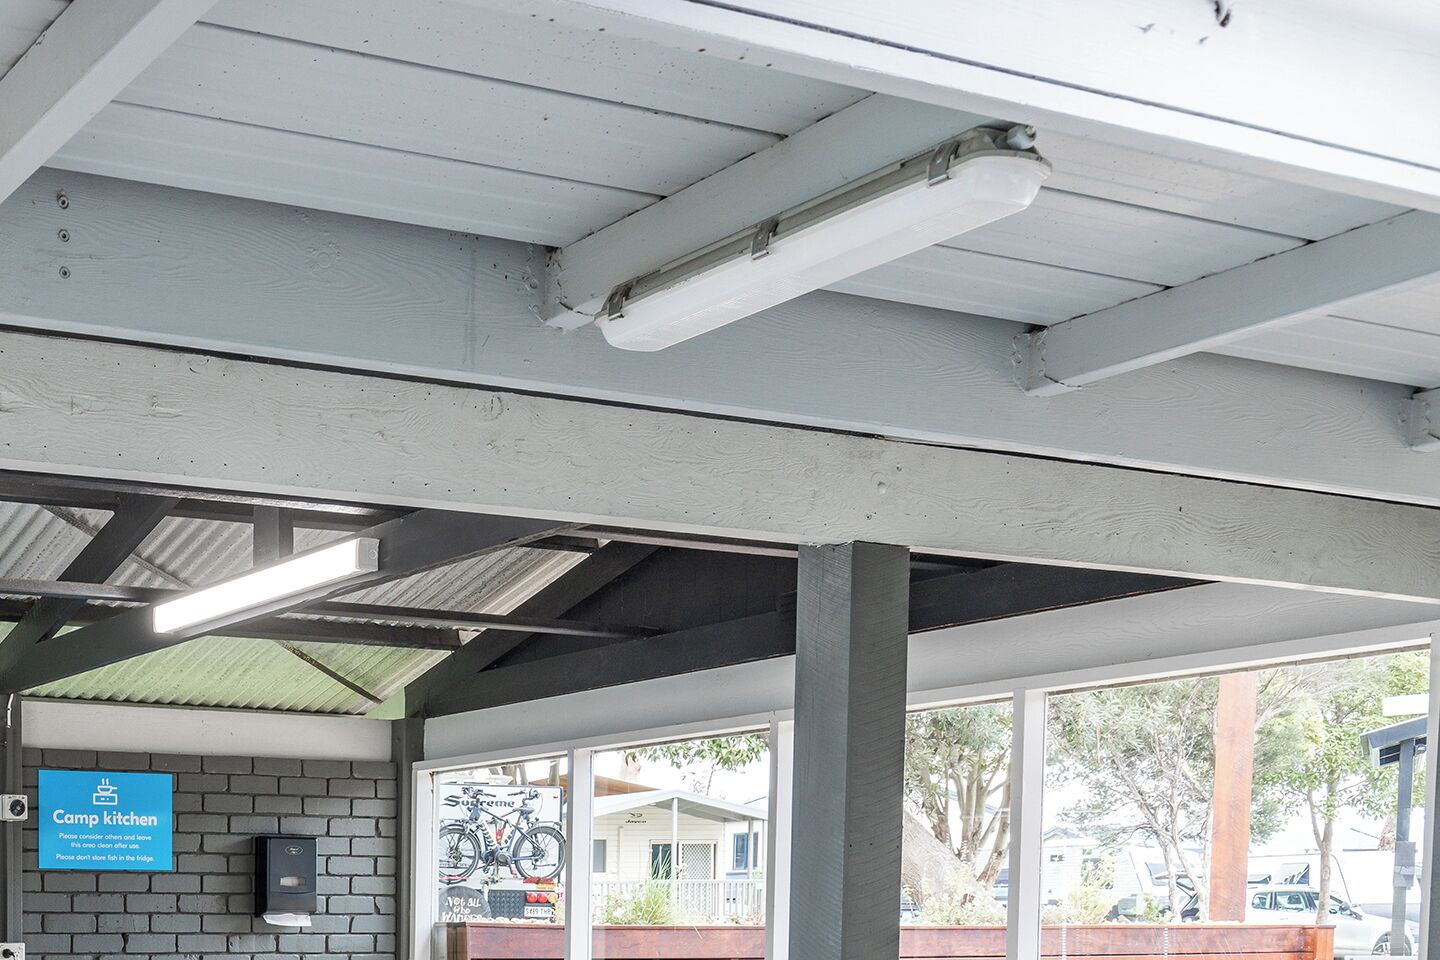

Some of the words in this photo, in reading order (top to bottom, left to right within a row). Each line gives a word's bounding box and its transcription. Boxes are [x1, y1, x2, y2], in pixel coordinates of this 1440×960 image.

[52, 809, 99, 828] Camp
[103, 811, 158, 826] kitchen
[445, 896, 465, 907] Not
